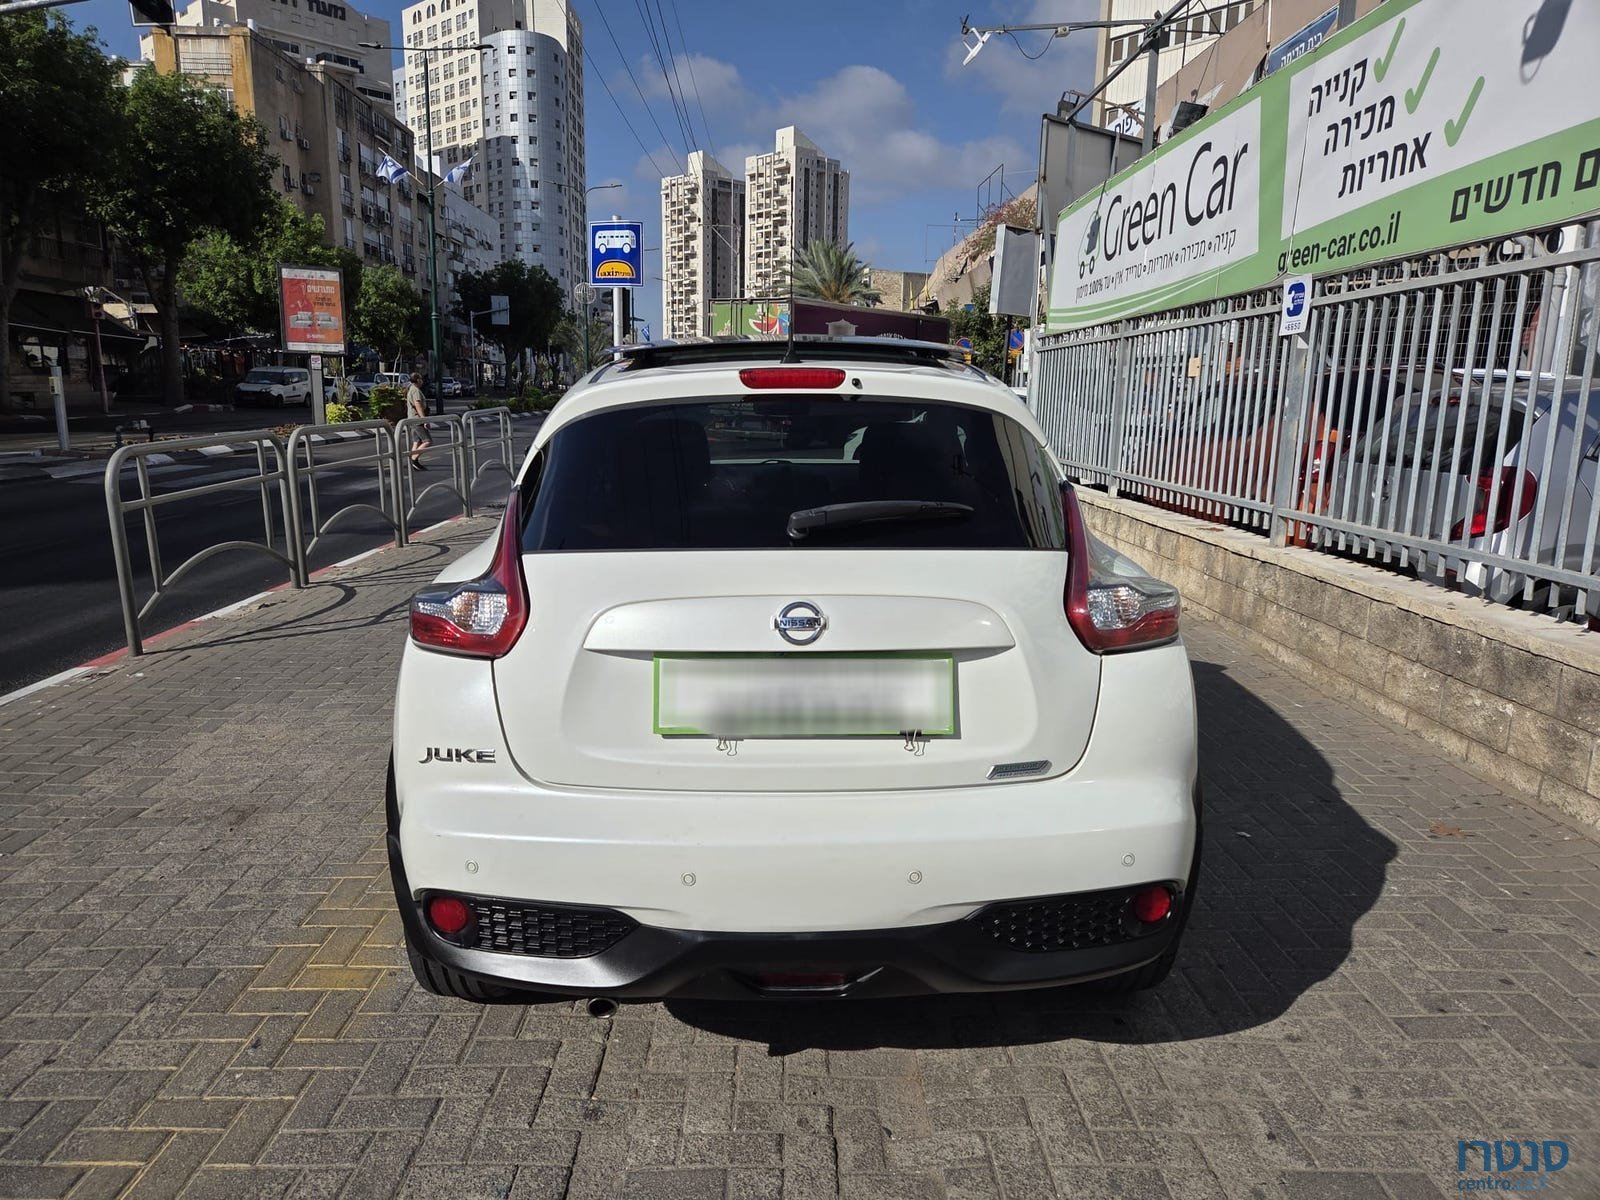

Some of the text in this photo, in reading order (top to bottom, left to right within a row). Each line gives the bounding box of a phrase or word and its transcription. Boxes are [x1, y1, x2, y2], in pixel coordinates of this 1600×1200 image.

[1307, 57, 1368, 118] קנייה
[1323, 95, 1396, 156] מכירה
[1338, 131, 1432, 198] אחריות
[1449, 160, 1563, 223] חדשים
[1103, 141, 1249, 262] Green Car
[1147, 250, 1175, 276] אחריות
[1180, 239, 1206, 264] מכירה
[1213, 228, 1237, 255] קניה
[1277, 210, 1401, 275] green-car.co.il
[780, 618, 822, 628] NISSAN
[417, 747, 497, 764] JUKE
